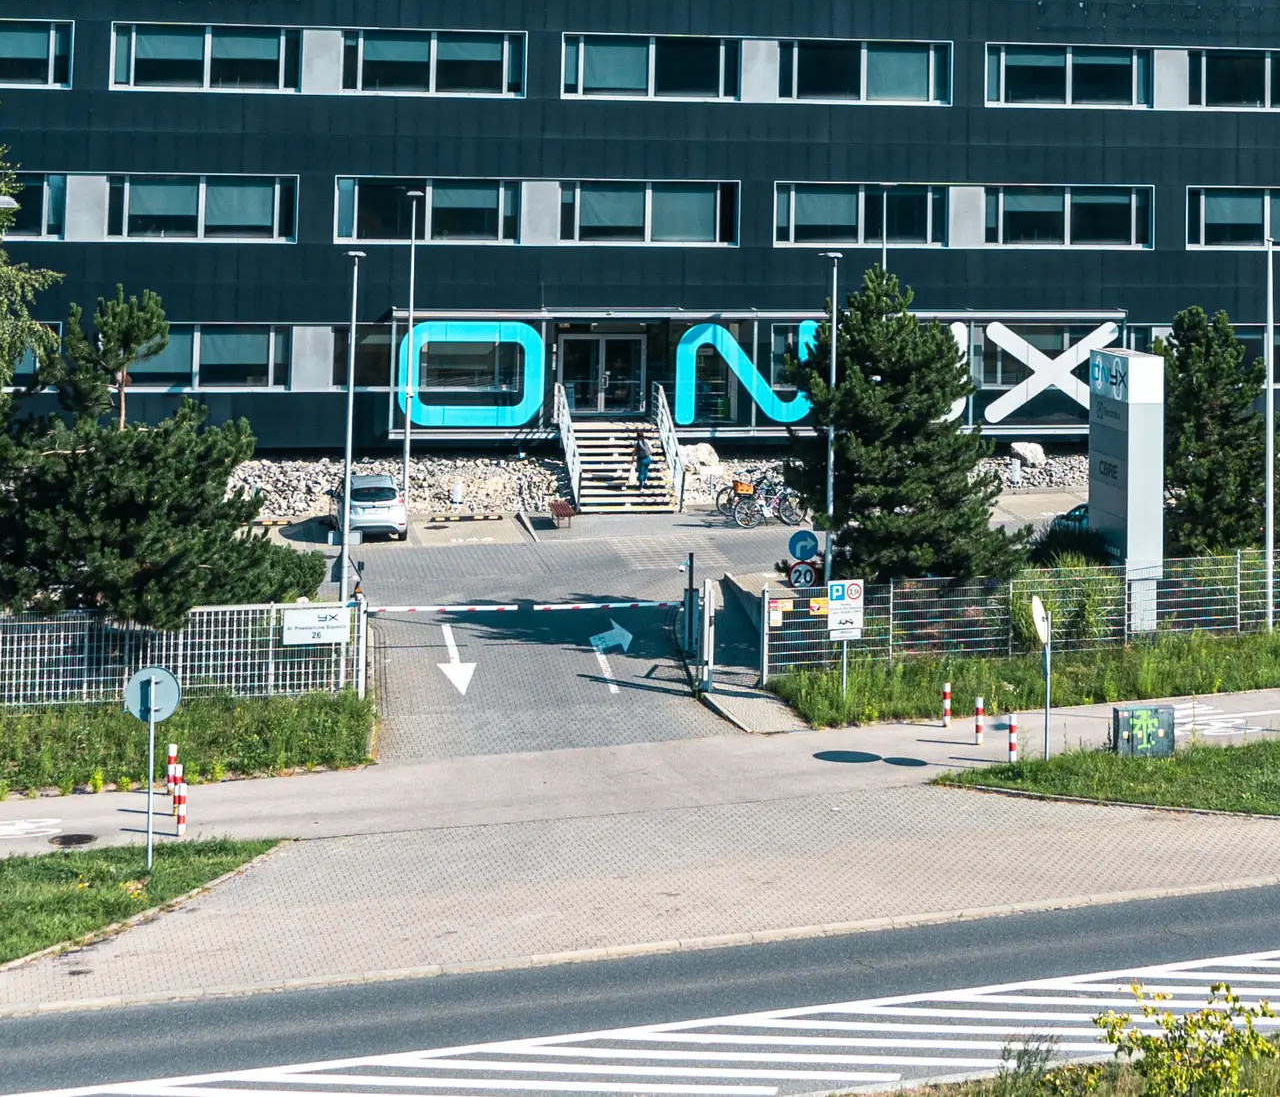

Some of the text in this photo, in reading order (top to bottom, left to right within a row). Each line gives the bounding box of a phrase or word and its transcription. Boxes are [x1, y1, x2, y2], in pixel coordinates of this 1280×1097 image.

[398, 319, 1119, 427] ONX
[1091, 363, 1128, 389] ONYX
[1098, 459, 1118, 481] CBRE
[793, 568, 814, 584] 20
[311, 631, 322, 639] 26
